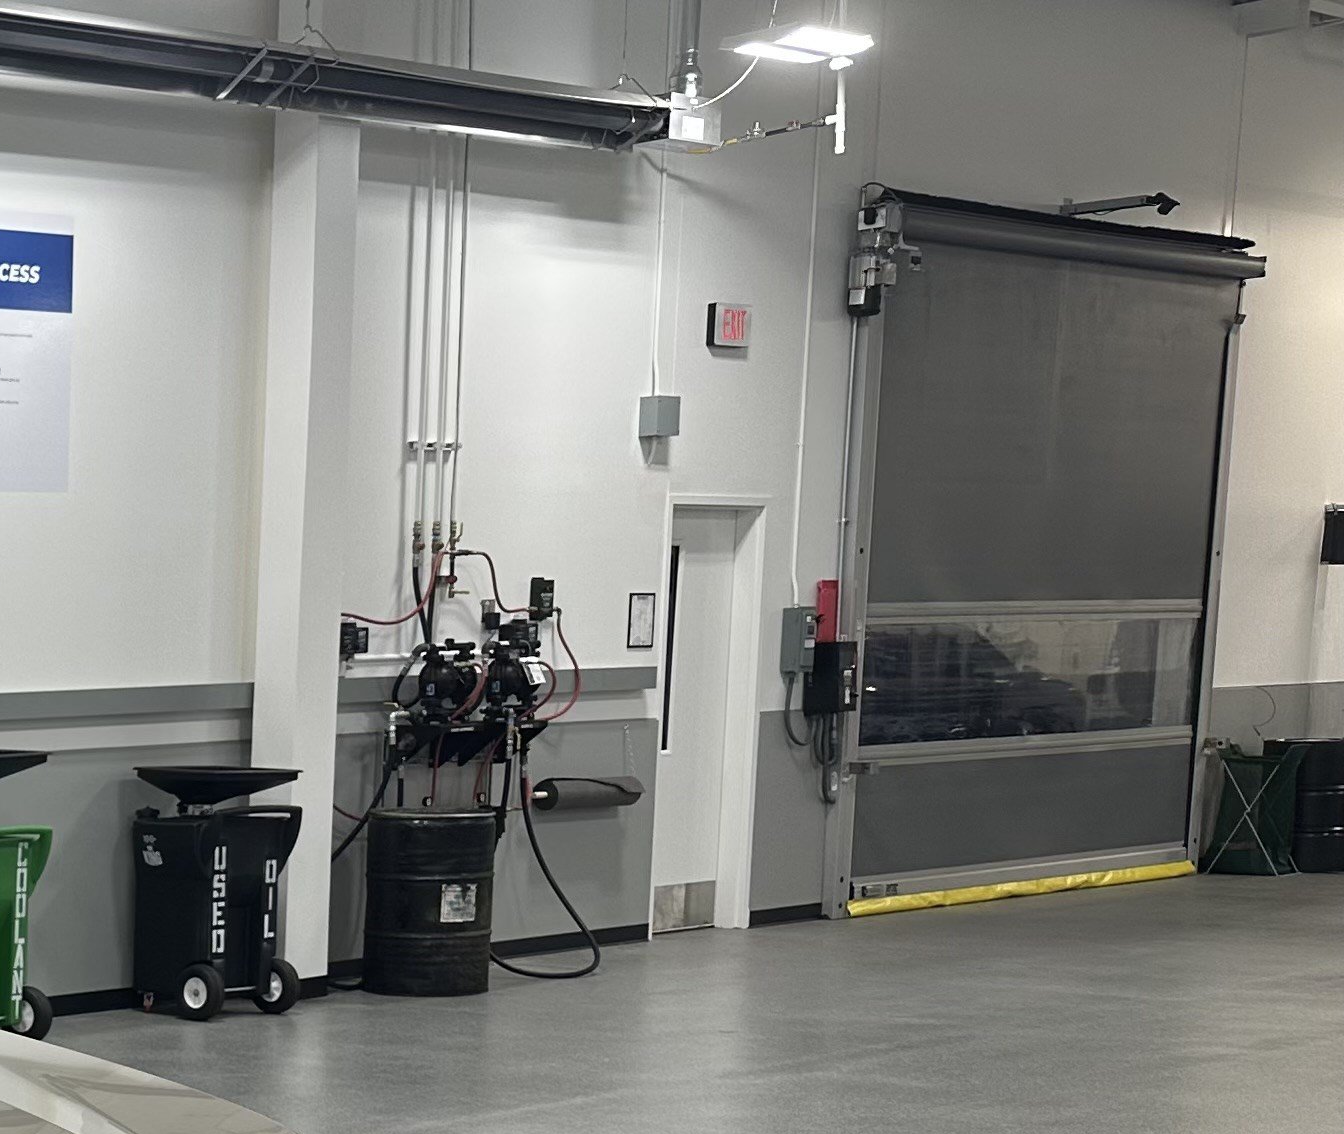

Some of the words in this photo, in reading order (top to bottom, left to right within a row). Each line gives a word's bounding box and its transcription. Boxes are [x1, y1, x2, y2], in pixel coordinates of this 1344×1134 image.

[722, 308, 747, 340] EXIT
[11, 842, 29, 1019] COOLANT
[212, 846, 227, 954] USED
[264, 859, 277, 938] OIL
